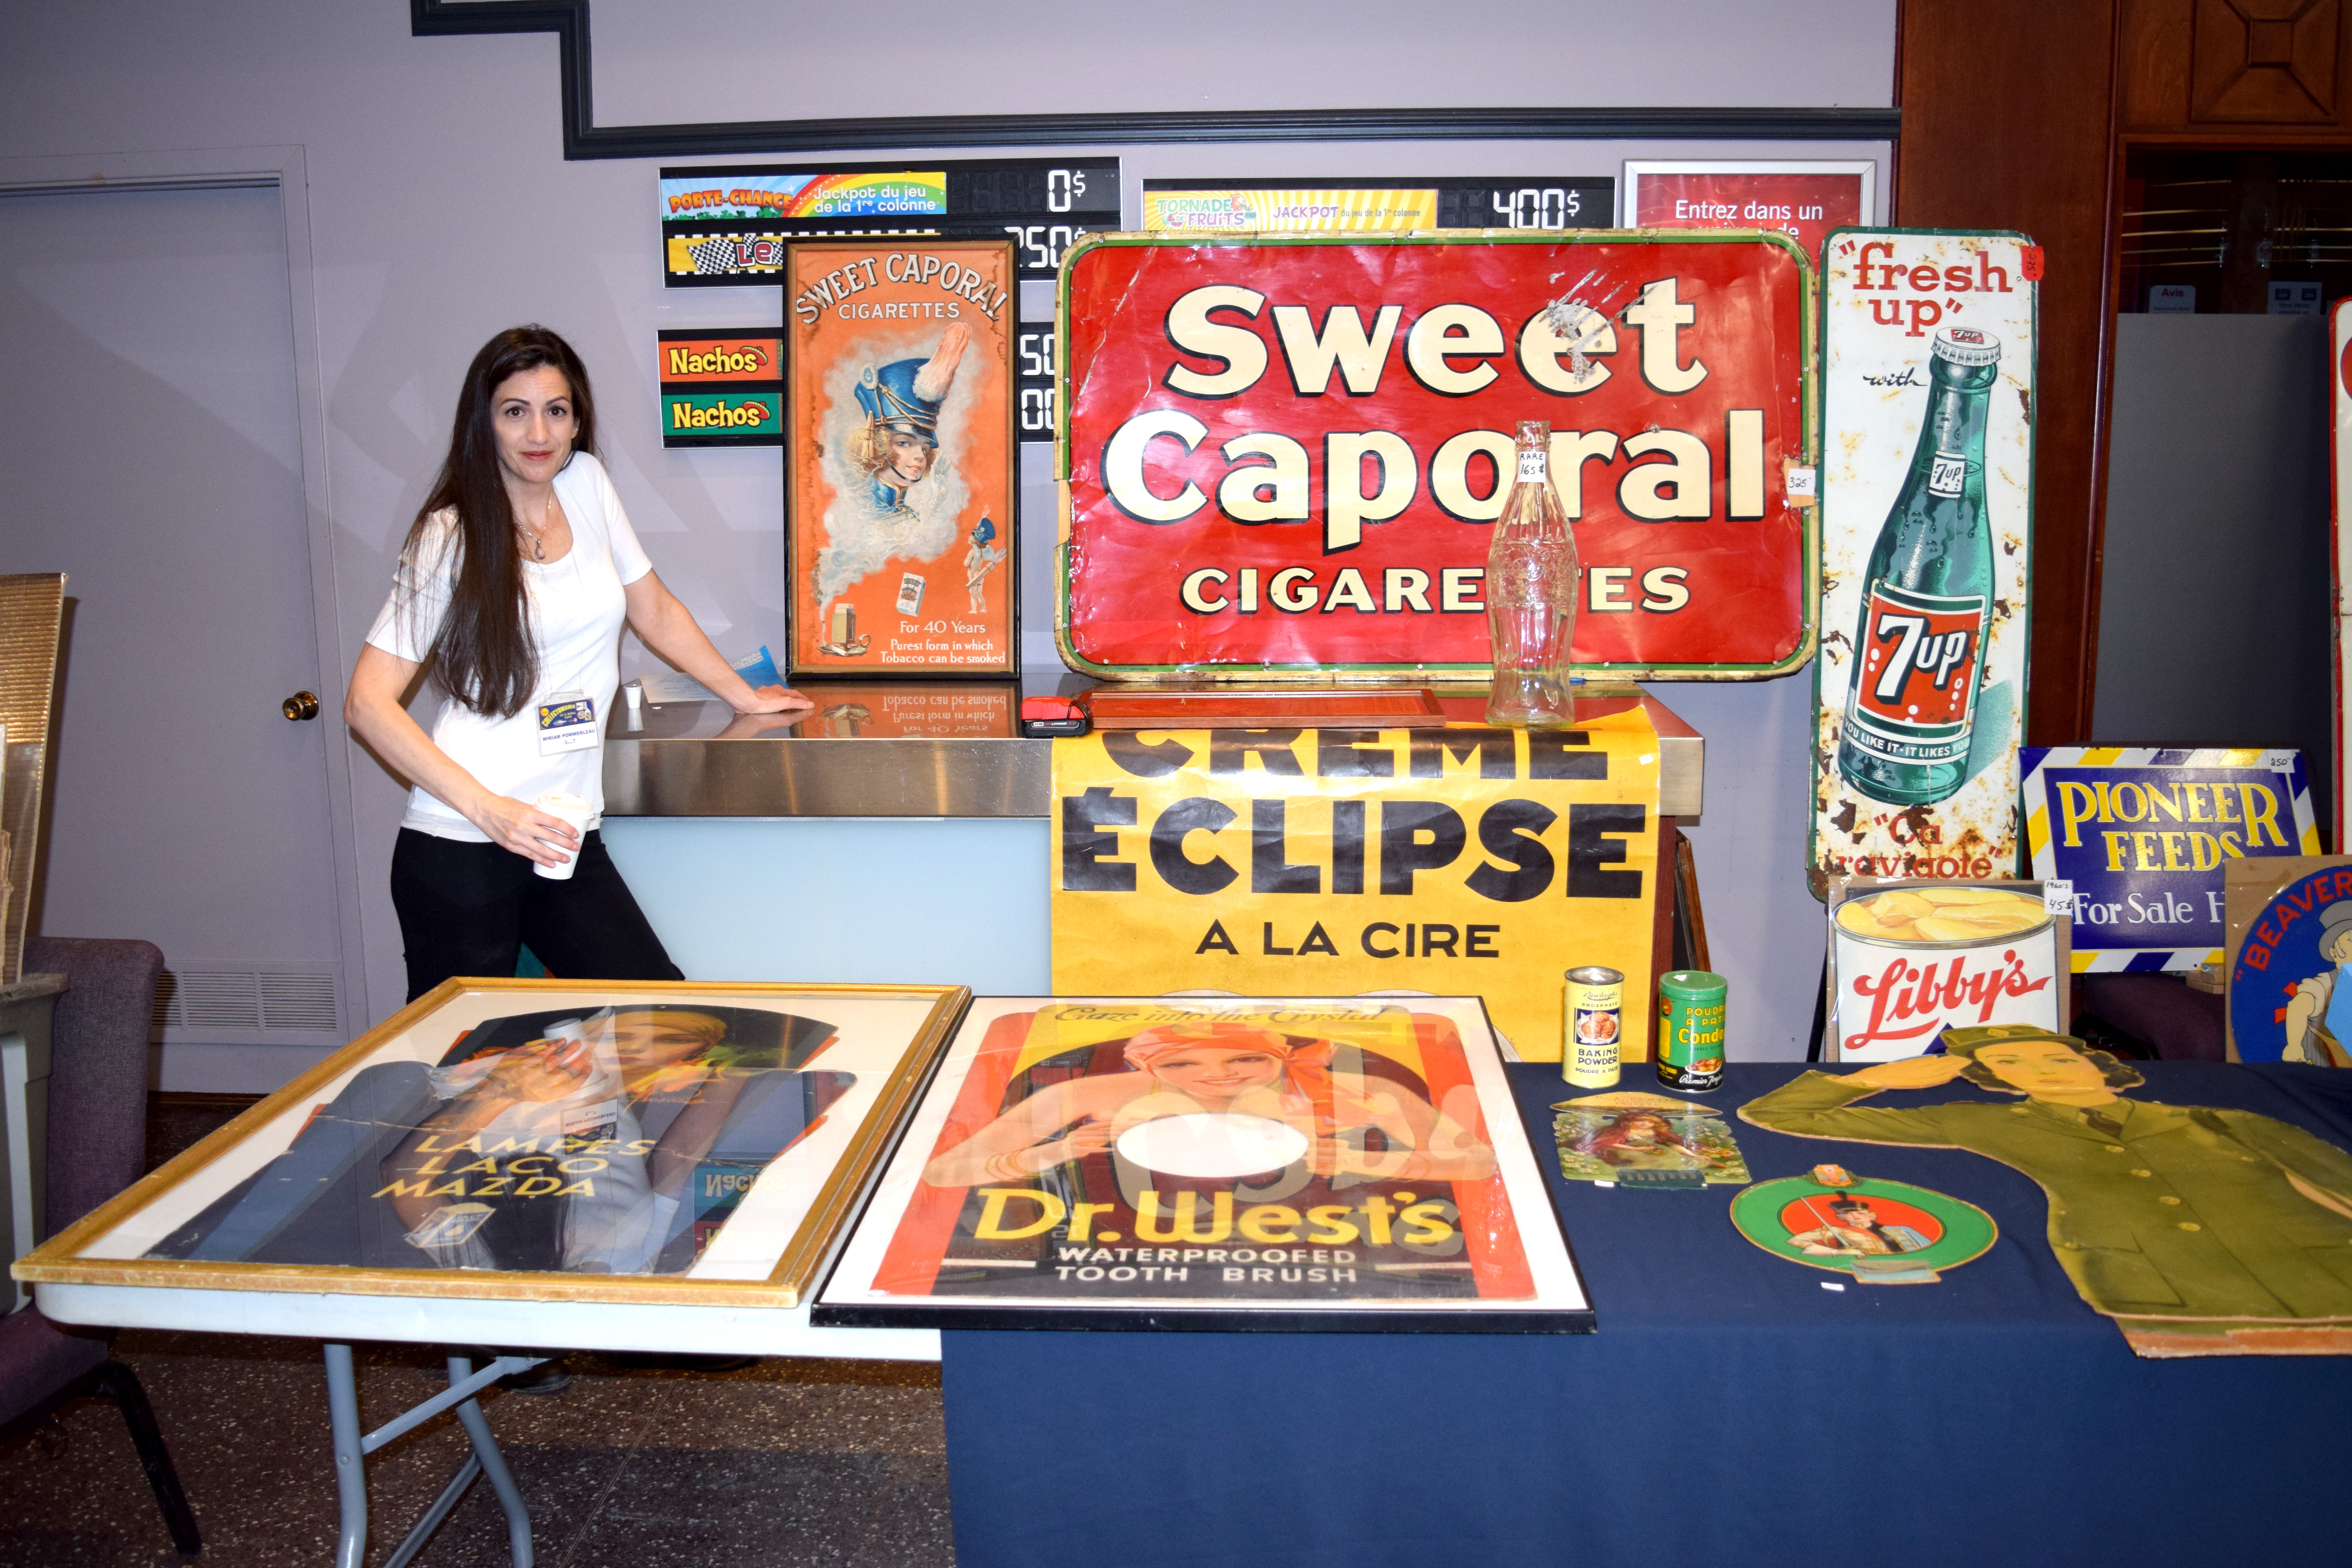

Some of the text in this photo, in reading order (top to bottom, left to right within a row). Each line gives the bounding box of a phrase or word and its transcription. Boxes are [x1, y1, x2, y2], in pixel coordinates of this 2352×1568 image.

[669, 189, 793, 213] PORTE-CHANCE
[814, 185, 926, 201] Jackpot du jeu
[814, 200, 833, 213] de
[838, 200, 852, 212] la
[878, 198, 936, 212] colonne
[1156, 198, 1232, 213] TORNADE
[1273, 206, 1339, 219] JACKPOT
[1341, 209, 1350, 217] du
[1351, 209, 1362, 219] jeu
[1363, 209, 1373, 217] de
[1375, 208, 1382, 217] la
[1393, 209, 1420, 217] colonne
[1675, 200, 1822, 220] Entrez dans un
[796, 254, 1008, 325] SWEET CAPORAL
[2161, 288, 2184, 298] Avis
[838, 302, 960, 320] CIGARETTES
[1163, 275, 1710, 400] Sweet
[670, 345, 757, 375] Nachos
[1863, 367, 1927, 387] with
[673, 400, 761, 430] Nachos
[1103, 408, 1766, 557] Caporal
[1179, 566, 1690, 615] CIGAREES
[900, 621, 985, 633] For 40 Years
[891, 639, 993, 651] Purest form in which
[880, 651, 1005, 663] Tobacco can be smoked
[562, 729, 595, 738] POMMERLEAU
[1845, 718, 1859, 738] YOU
[1861, 732, 1884, 750] LIKE
[1919, 746, 1950, 757] LIKES
[1952, 737, 1970, 752] YOU
[2056, 781, 2288, 847] PIONEER
[1062, 786, 1646, 902] ÉCLIPSE
[2102, 831, 2244, 871] FEEDS
[2073, 893, 2122, 925] For
[2127, 892, 2194, 924] Sale
[1195, 918, 1501, 958] A LA CIRE
[1844, 950, 2053, 1050] Libby's
[1055, 1007, 1388, 1024] Gaze into the Crystal
[1686, 1018, 1694, 1027] A
[1678, 1027, 1724, 1045] Condo
[1578, 1047, 1617, 1057] BAKING
[1578, 1056, 1617, 1065] POWDER
[1679, 1074, 1708, 1084] Premier
[414, 1135, 657, 1155] LAMPES
[416, 1156, 610, 1175] LACO
[371, 1176, 596, 1198] MAZDA
[1058, 1247, 1357, 1263] WATERPROOFED
[1055, 1266, 1357, 1283] TOOTH BRUSH
